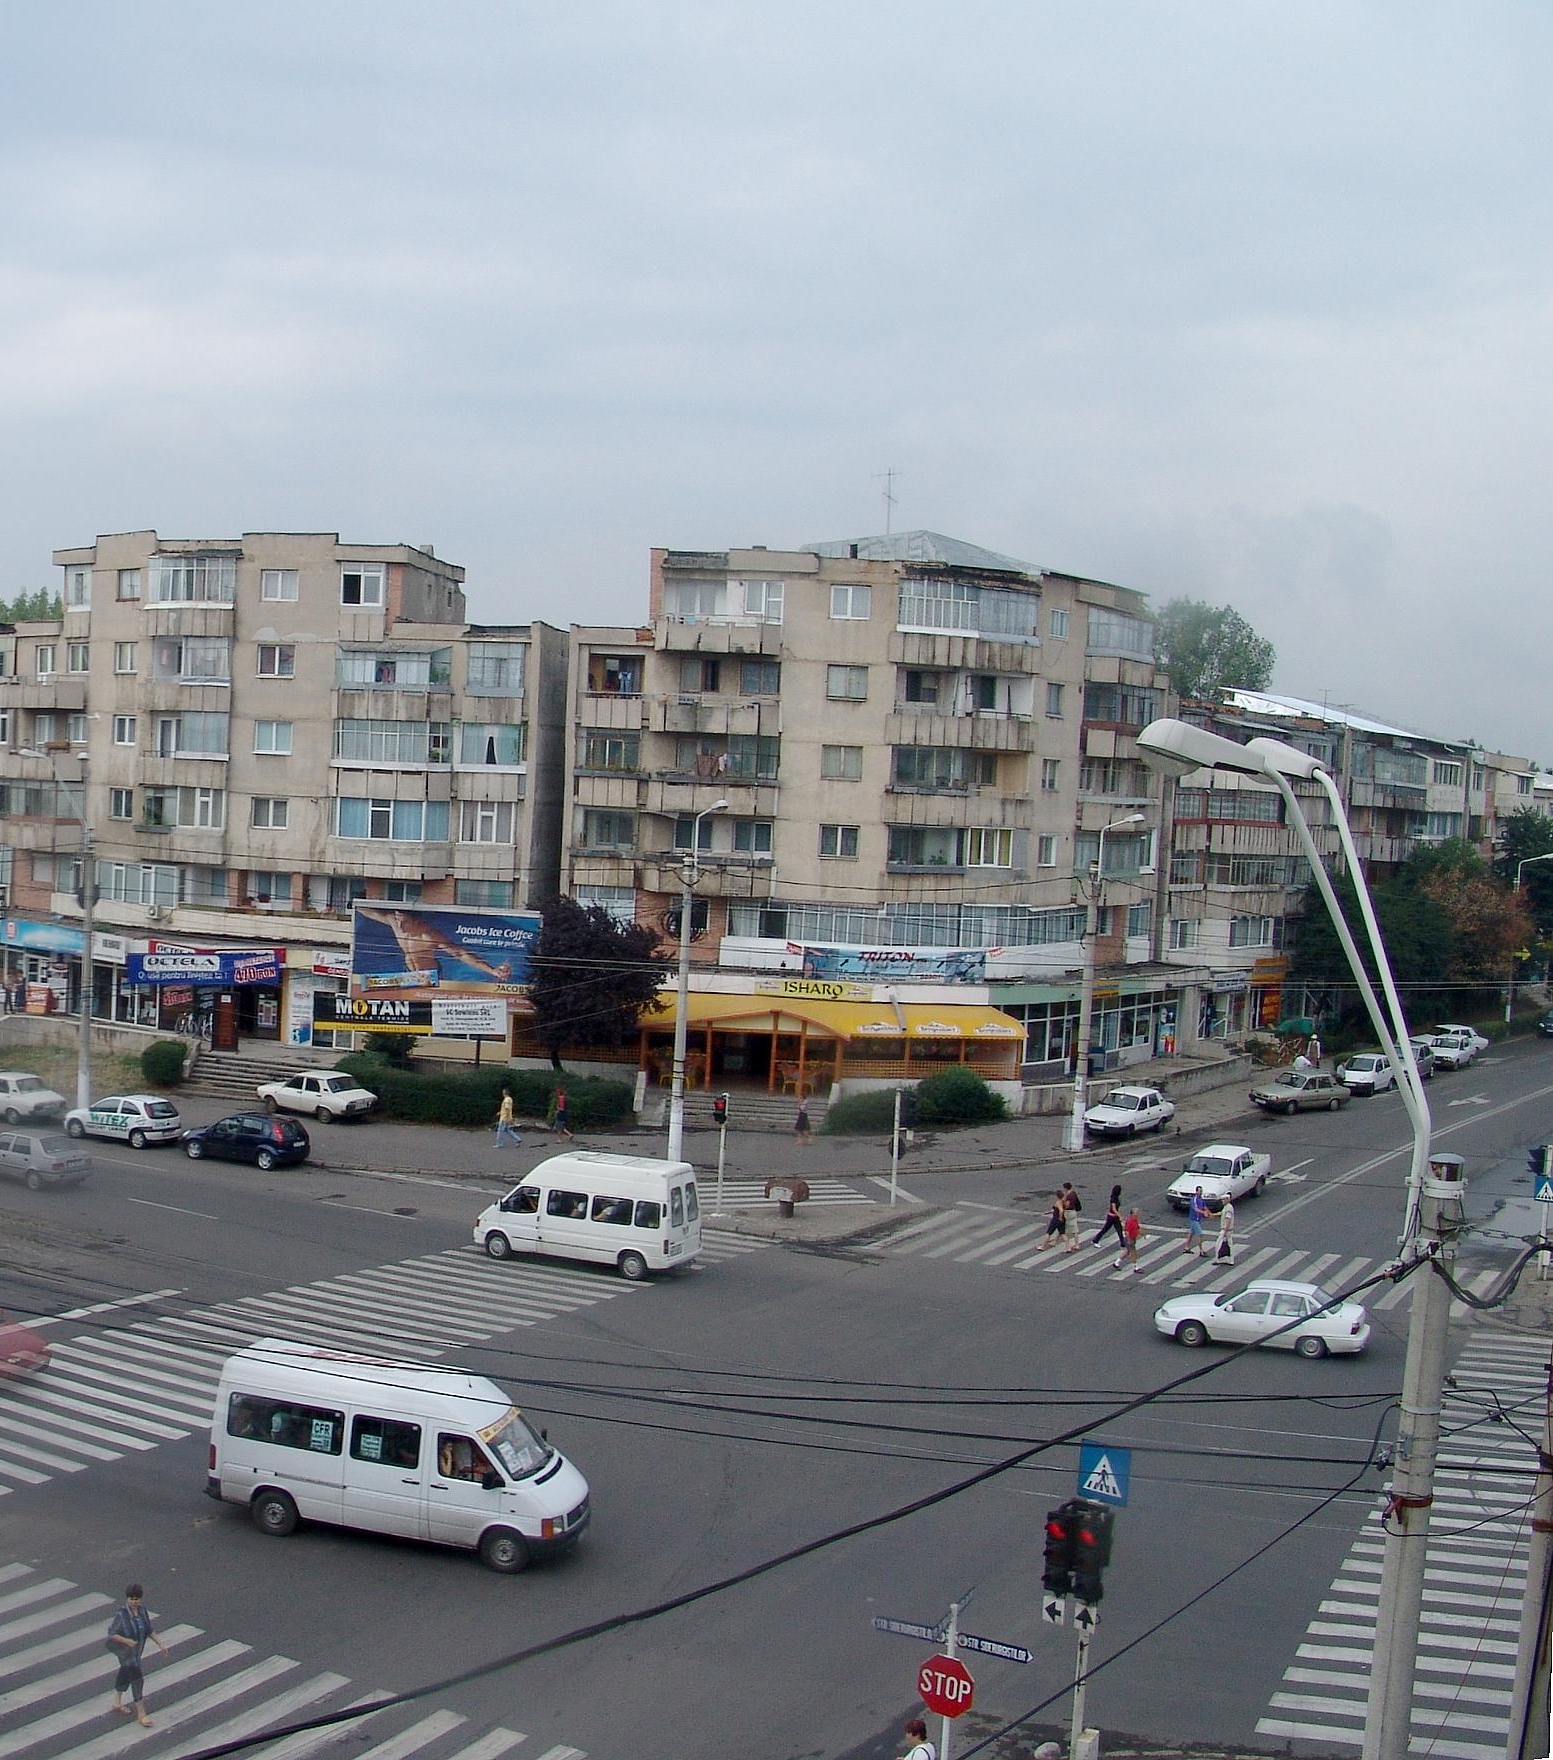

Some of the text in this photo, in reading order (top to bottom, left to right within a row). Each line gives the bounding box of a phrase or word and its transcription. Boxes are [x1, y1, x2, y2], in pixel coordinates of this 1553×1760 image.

[455, 925, 534, 941] Jacobs Ice Coffee
[335, 1000, 410, 1016] MOTAN
[314, 1422, 331, 1435] CFR
[920, 1668, 971, 1703] STOP
